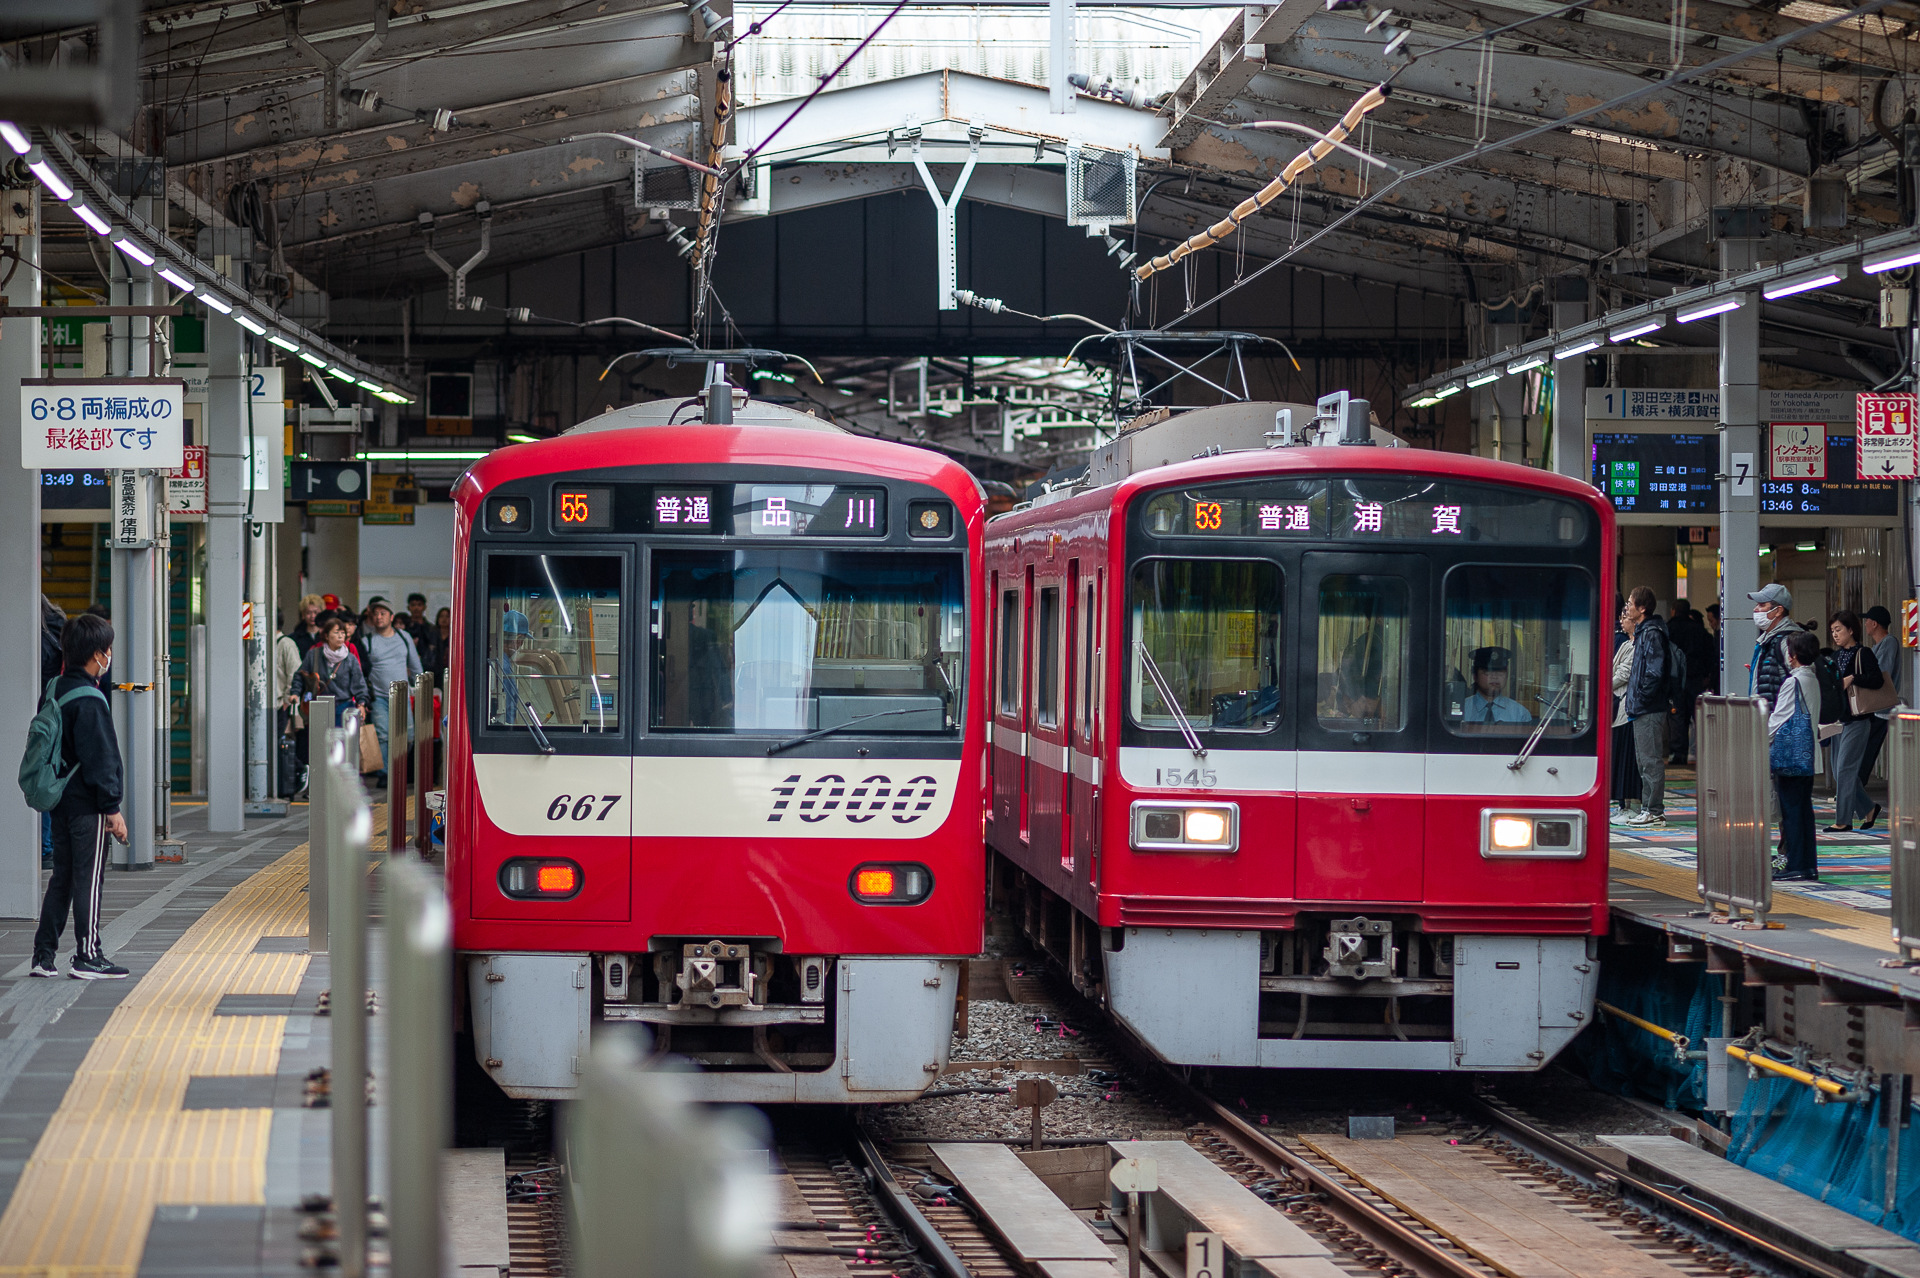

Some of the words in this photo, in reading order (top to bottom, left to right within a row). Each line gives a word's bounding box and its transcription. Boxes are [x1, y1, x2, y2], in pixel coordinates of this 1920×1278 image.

[252, 374, 266, 396] 2
[1605, 394, 1613, 414] 1
[1632, 392, 1686, 404] 羽田空港
[1702, 393, 1720, 403] HN
[1814, 392, 1838, 400] Airport
[1868, 401, 1908, 412] STOP
[45, 427, 158, 450] 最後部です
[1864, 438, 1912, 446] 非常停止ボタン
[184, 452, 201, 460] OP
[1774, 445, 1823, 455] インターホン
[1601, 464, 1606, 475] 1
[1736, 464, 1750, 486] 7
[40, 474, 74, 486] 13:49
[83, 474, 92, 486] 8
[1600, 481, 1606, 492] 1
[1649, 482, 1687, 492] 羽田空港
[1762, 483, 1794, 494] 13:45
[1801, 483, 1810, 494] 8
[561, 493, 588, 523] 55
[656, 496, 710, 523] 普通
[762, 496, 876, 528] 品川
[1762, 500, 1794, 511] 13:46
[1801, 500, 1809, 511] 6
[1196, 502, 1222, 530] 53
[1258, 504, 1310, 531] 普通
[1353, 502, 1462, 534] 浦賀
[120, 518, 137, 544] 使用中
[1156, 768, 1218, 788] 1545
[547, 794, 622, 822] 667
[766, 774, 938, 824] 1000
[1196, 1237, 1209, 1268] 1
